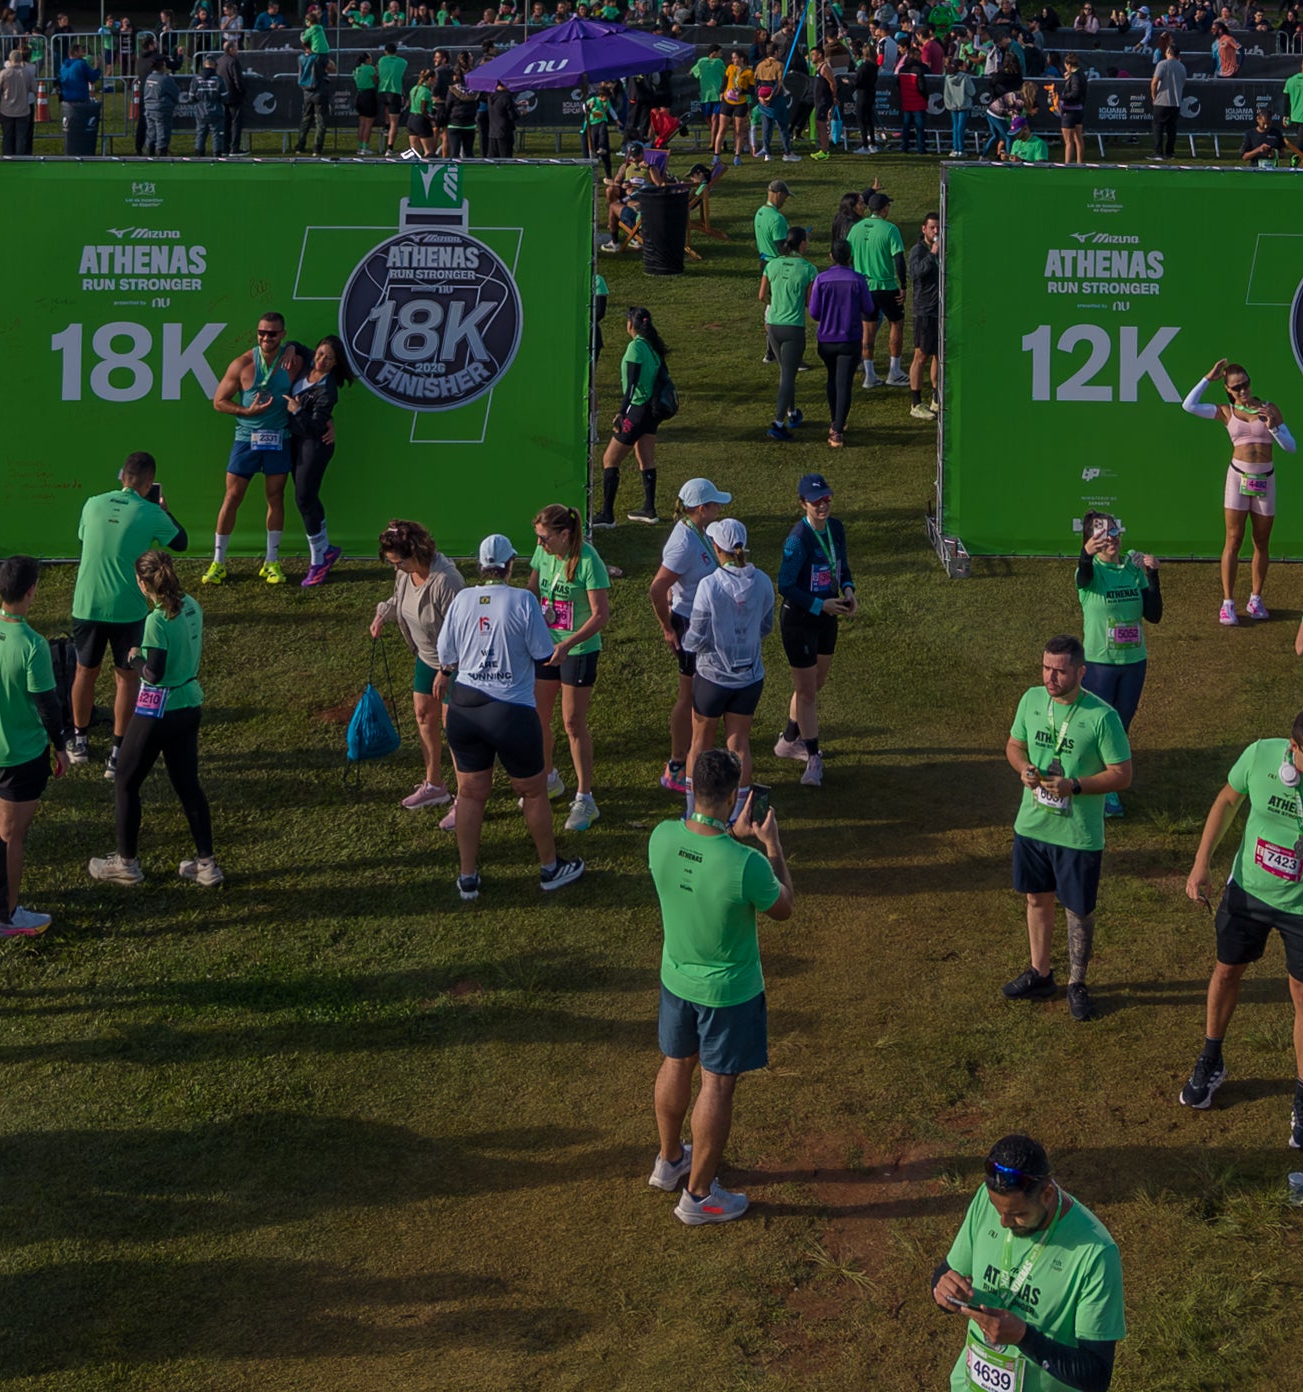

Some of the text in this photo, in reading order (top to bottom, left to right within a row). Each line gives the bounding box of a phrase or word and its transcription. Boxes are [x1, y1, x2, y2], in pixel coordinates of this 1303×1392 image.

[78, 245, 207, 274] ATHENAS
[386, 245, 480, 269] ATHENAS
[1044, 249, 1164, 279] ATHENAS
[390, 269, 476, 280] RUN STRONGER
[82, 278, 202, 291] RUN STRONGER
[1048, 282, 1160, 295] RUN STRONGER
[368, 298, 498, 362] 18K
[51, 321, 228, 402] 18K
[415, 363, 446, 374] 2026
[1022, 324, 1183, 403] 12K
[375, 361, 491, 398] FINISHER
[260, 434, 278, 442] 2331
[1106, 588, 1139, 599] ATHENAS
[479, 661, 498, 669] ARE
[1035, 730, 1074, 749] ATHAS
[678, 850, 703, 863] ATHENAS
[1267, 852, 1298, 870] 7423
[973, 1360, 1011, 1390] 4639
